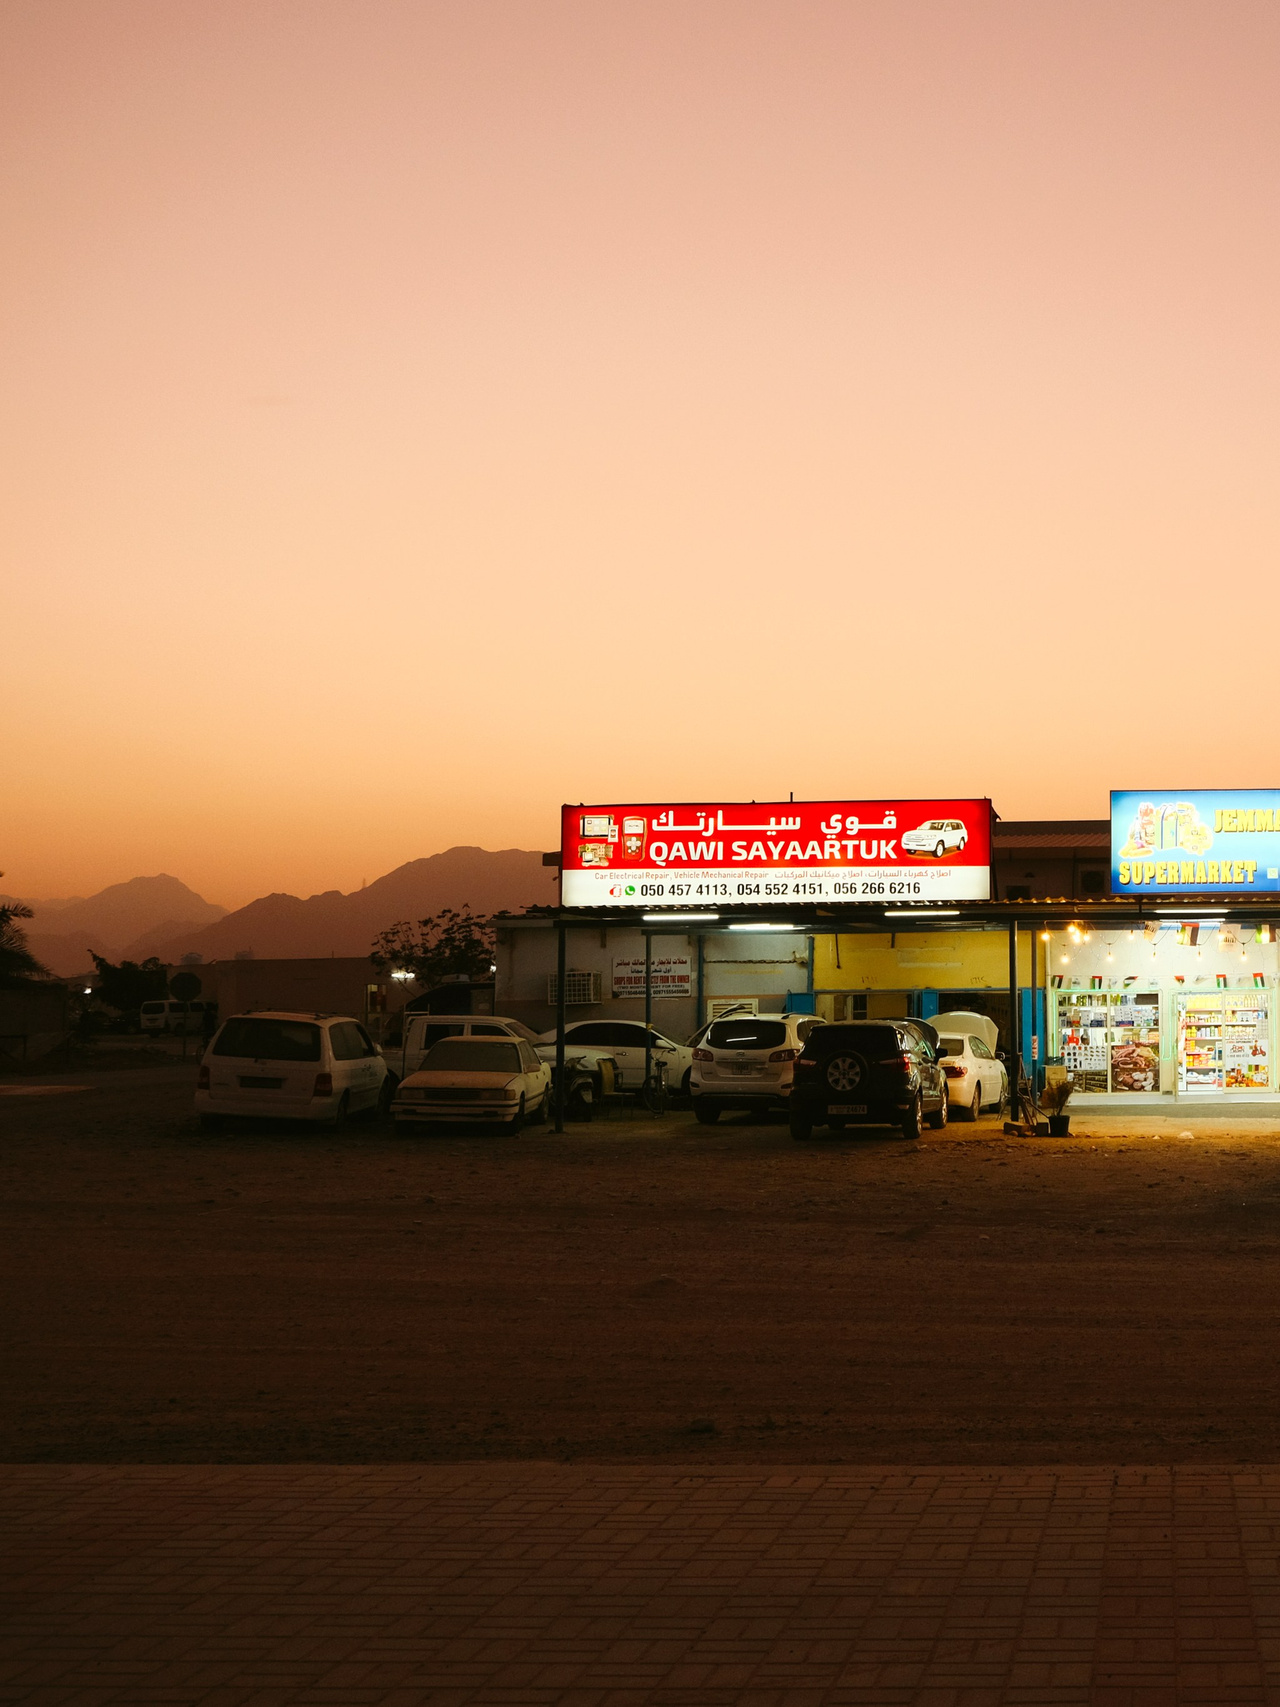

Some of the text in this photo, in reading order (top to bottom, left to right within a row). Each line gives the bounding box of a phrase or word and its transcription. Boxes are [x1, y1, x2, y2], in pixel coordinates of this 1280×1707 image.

[652, 810, 897, 839] قوي سيارتك
[650, 840, 897, 867] QAWI SAYAARTUK
[595, 871, 769, 881] Car Electrical Repair, Vehicle Mechanical Repair
[1119, 860, 1257, 885] SUPERMARKET
[641, 881, 921, 898] 050 457 4113, 054 552 4151, 056 266 6216
